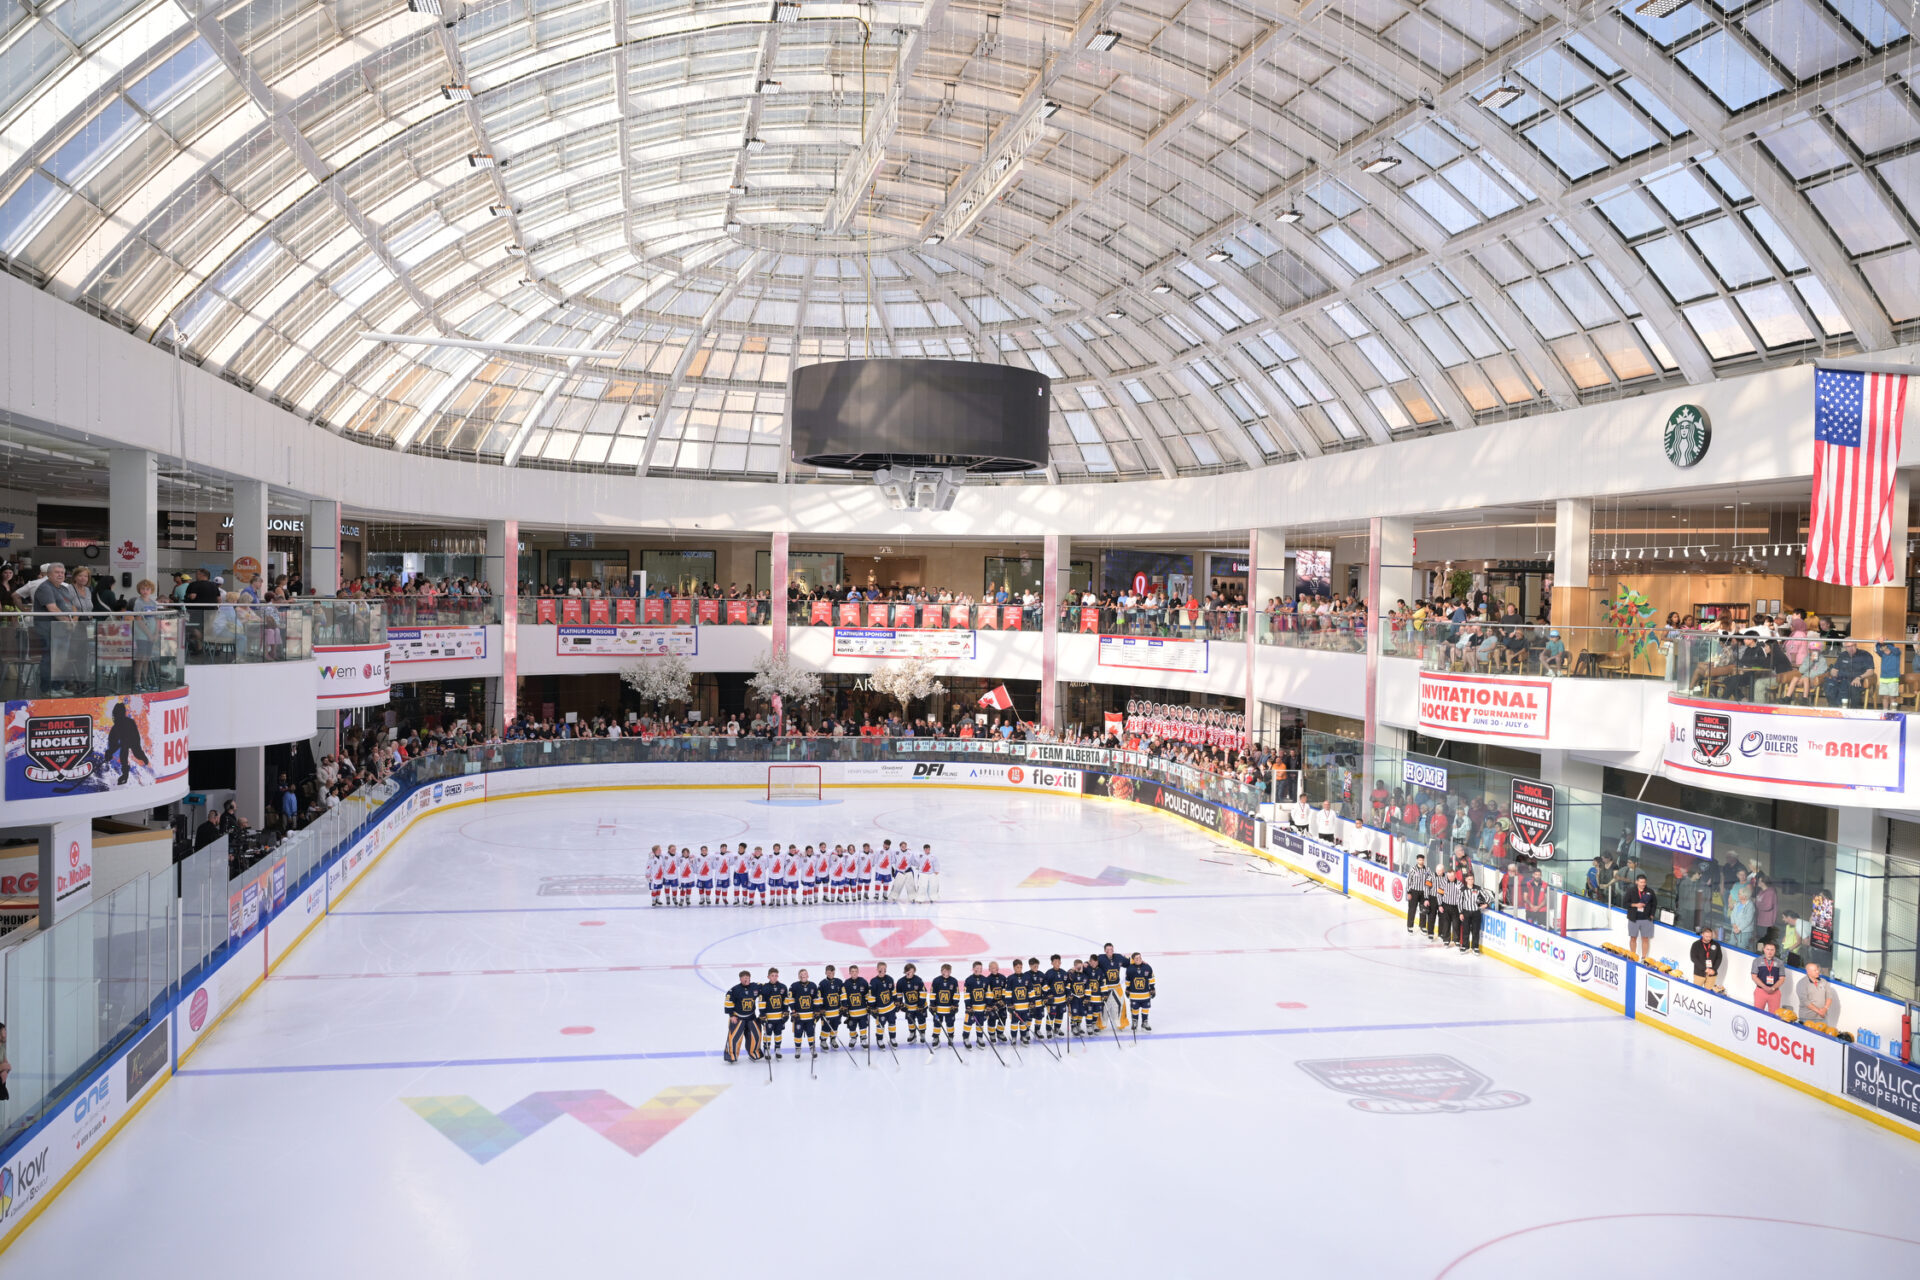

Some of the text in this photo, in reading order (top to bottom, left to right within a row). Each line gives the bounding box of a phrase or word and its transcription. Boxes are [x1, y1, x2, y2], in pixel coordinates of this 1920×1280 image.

[222, 517, 234, 528] JA
[373, 664, 382, 676] LG
[1422, 683, 1538, 709] INVITATIONAL
[1421, 702, 1471, 723] HOCKEY
[1473, 708, 1537, 720] TOURNAMENT
[35, 728, 84, 736] INVITATIONAL
[48, 720, 75, 730] BRICK
[1473, 718, 1488, 726] JUNE
[1505, 720, 1522, 728] JULY
[31, 736, 88, 749] HOCKEY
[1676, 727, 1686, 742] LG
[1695, 729, 1728, 740] HOCKEY
[1765, 733, 1798, 743] EDMONTON
[1038, 746, 1063, 761] TEAM
[1065, 748, 1100, 764] ALBERTA
[1764, 742, 1798, 754] OILERS
[1808, 740, 1888, 760] The BRICK
[913, 763, 945, 777] DFI
[1033, 769, 1077, 788] flexiti
[1406, 763, 1444, 788] HOME
[1164, 792, 1216, 826] POULET ROUGE
[1513, 802, 1551, 821] HOCKEY
[1642, 817, 1708, 854] AWAY
[1308, 844, 1340, 865] BIG WEST
[1, 872, 39, 895] RG
[57, 876, 68, 892] Dr.
[69, 864, 91, 887] Mobile
[1357, 866, 1385, 892] BRICK
[1514, 927, 1566, 961] impactico
[1595, 956, 1619, 972] EDMONTON
[1594, 965, 1619, 986] OILERS
[1673, 992, 1712, 1019] AKASH
[1757, 1026, 1815, 1066] BOSCH
[1327, 1070, 1466, 1085] HOCKEY
[74, 1075, 110, 1123] ONE
[18, 1146, 49, 1197] kovr
